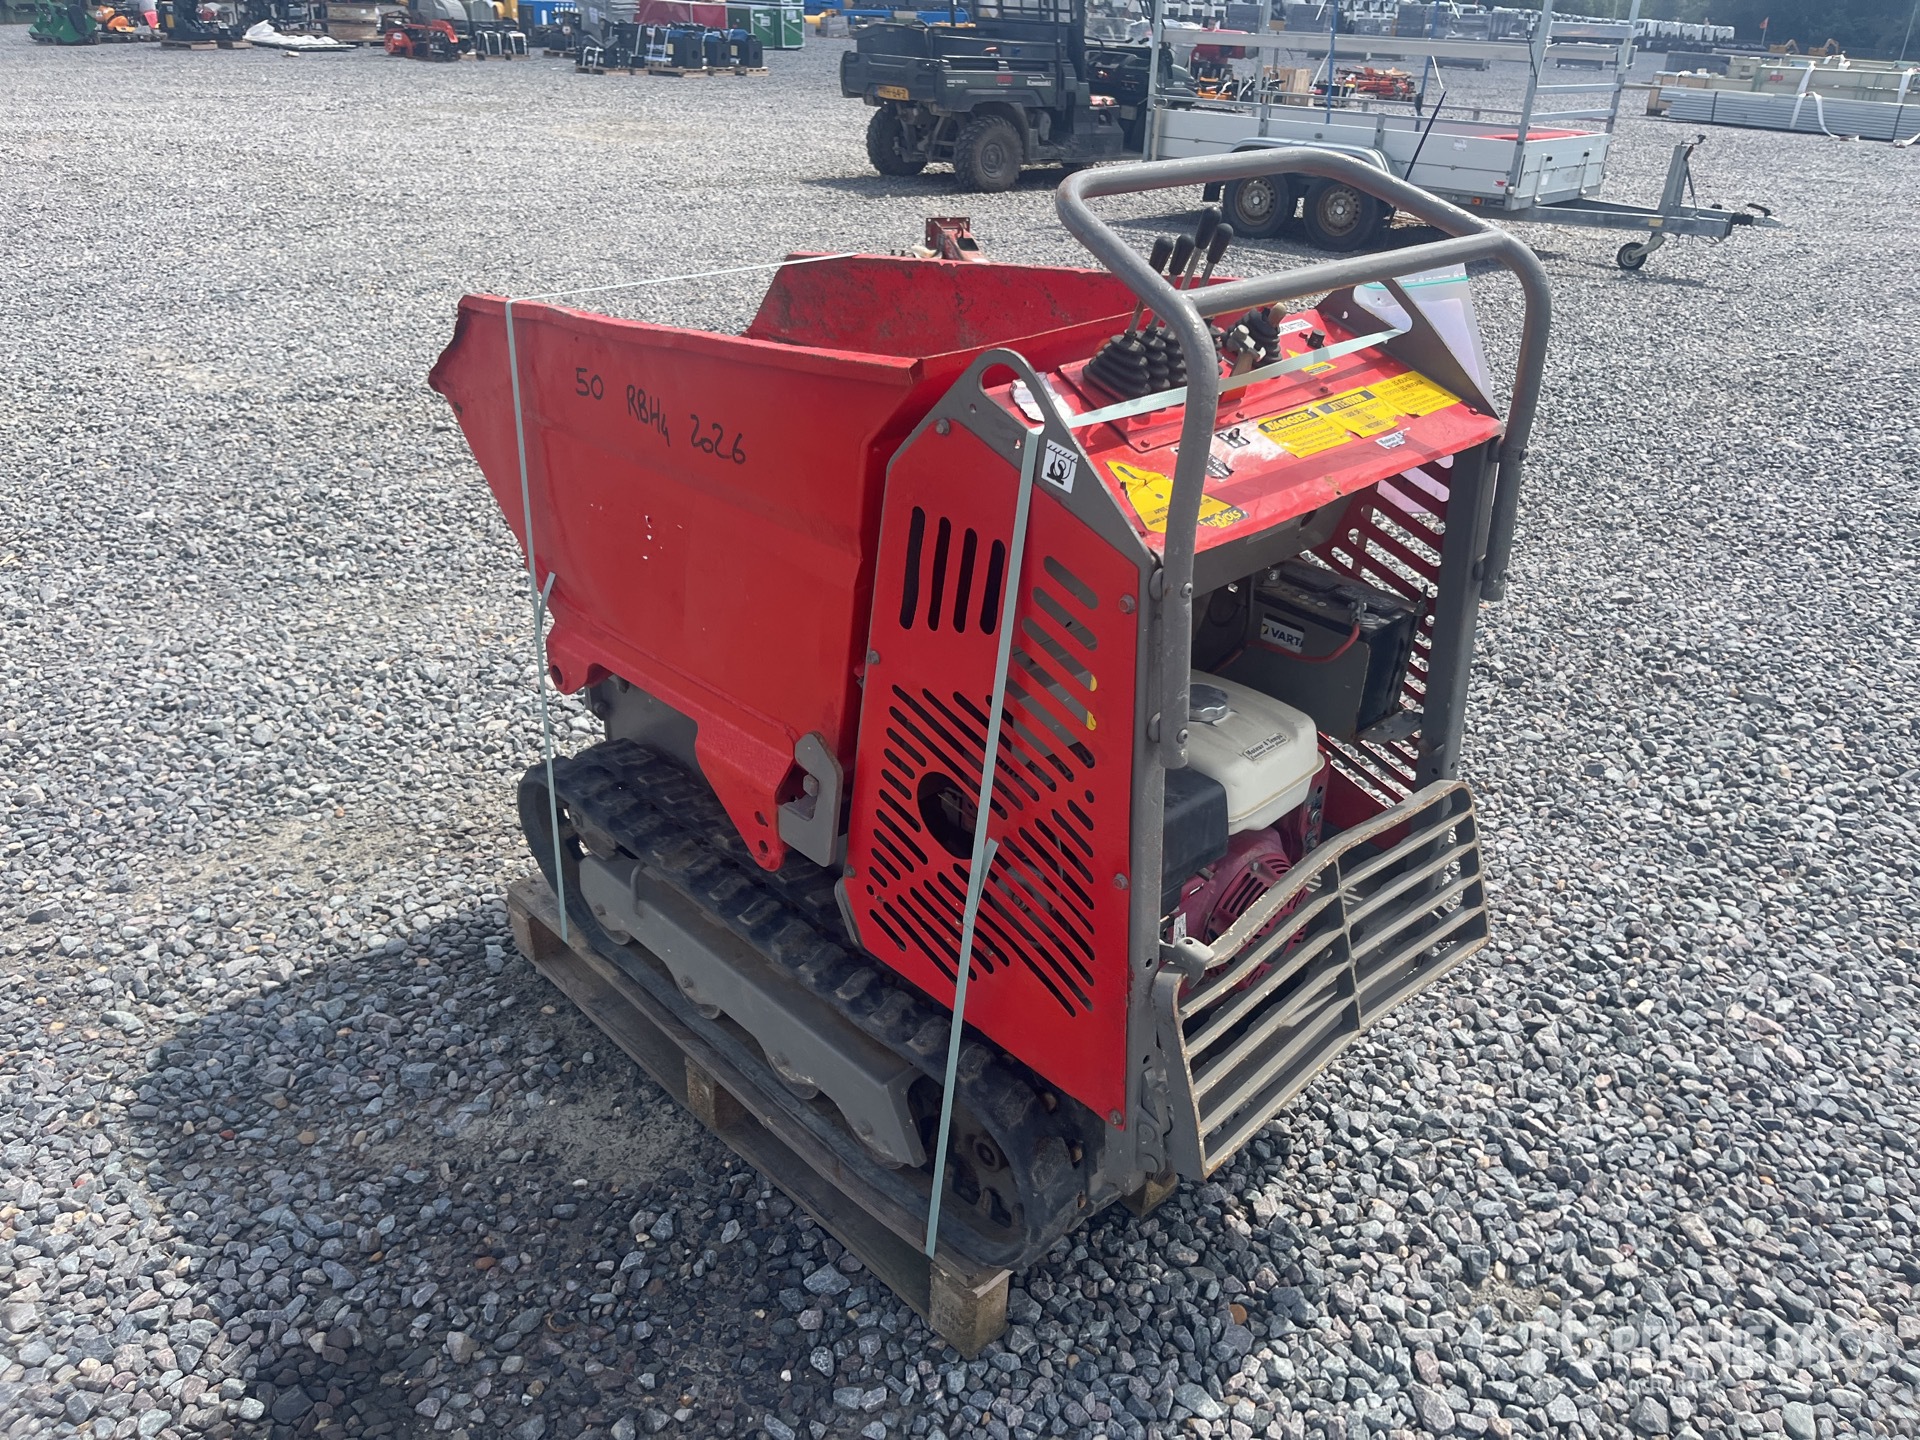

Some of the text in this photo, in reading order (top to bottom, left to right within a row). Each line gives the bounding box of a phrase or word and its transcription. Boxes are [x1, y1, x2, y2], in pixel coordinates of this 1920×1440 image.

[1327, 393, 1368, 411] ATTENTION
[575, 367, 746, 465] 50 RBH4 2026
[1263, 411, 1313, 432] DANGER
[1271, 627, 1303, 648] VART
[1245, 743, 1264, 756] Moteur
[1267, 734, 1284, 746] Temps
